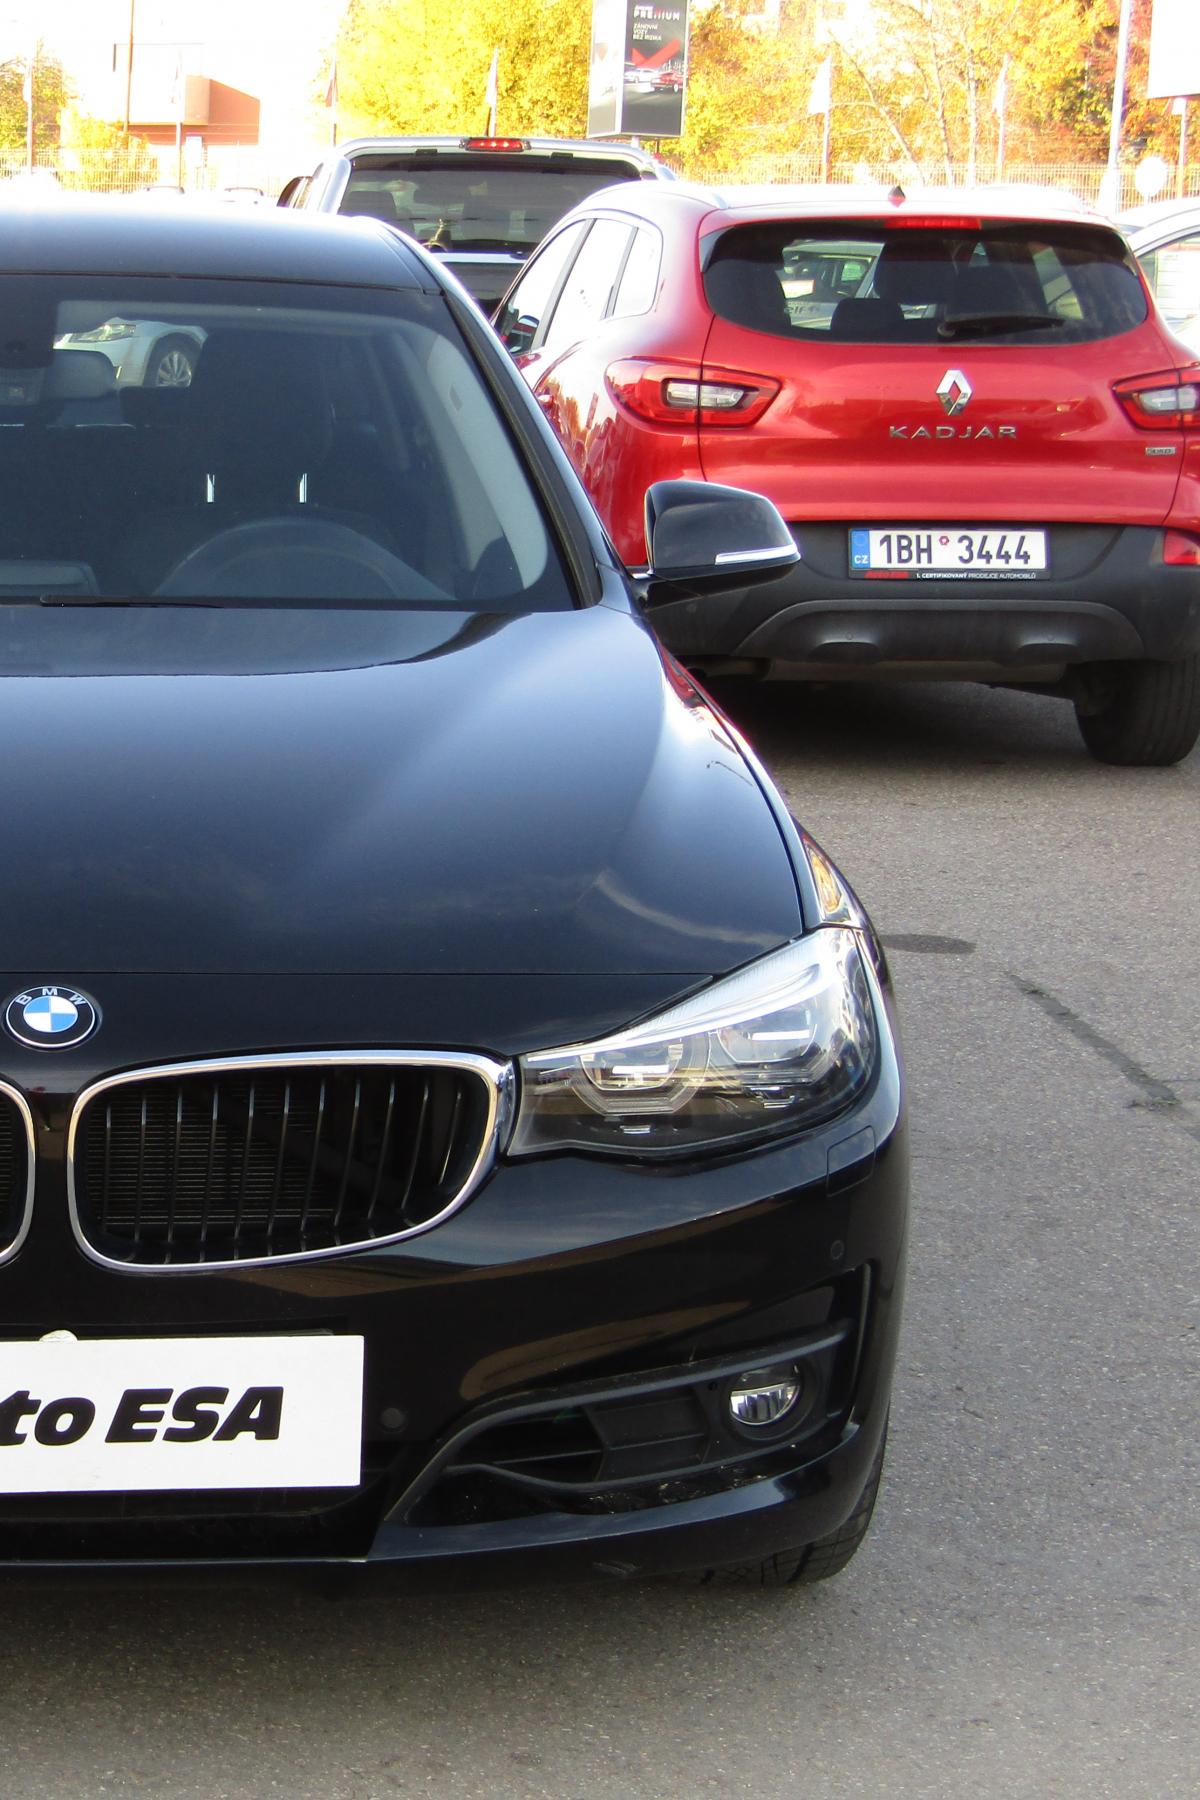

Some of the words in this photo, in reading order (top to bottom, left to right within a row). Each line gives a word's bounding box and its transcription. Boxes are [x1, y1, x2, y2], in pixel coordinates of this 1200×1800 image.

[889, 425, 1017, 440] KADJAR
[879, 534, 933, 565] 1BH
[957, 534, 1032, 565] 3444
[854, 555, 870, 565] CZ
[15, 987, 88, 1006] BMW
[104, 1385, 284, 1443] ESA
